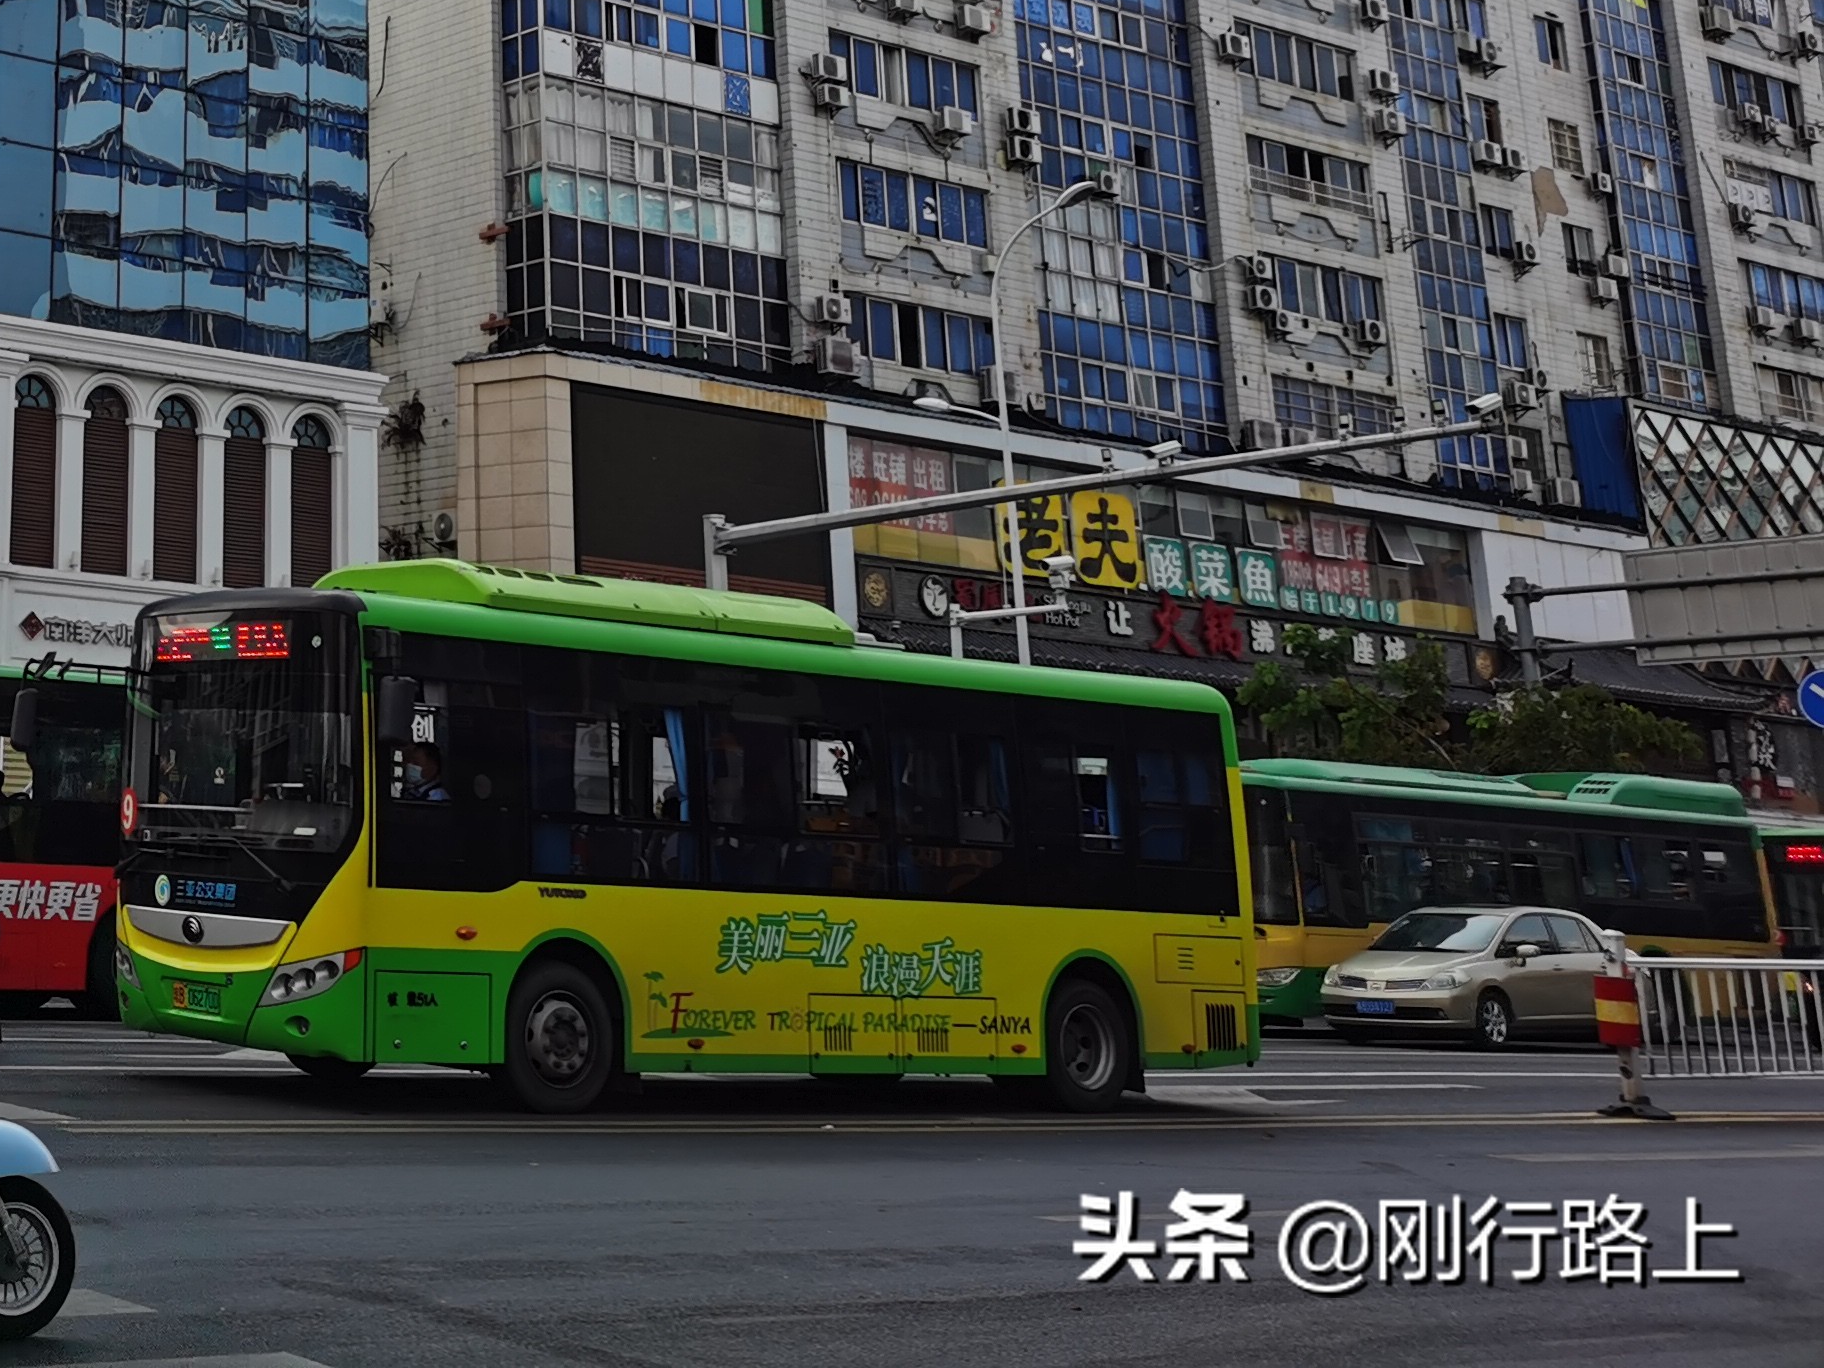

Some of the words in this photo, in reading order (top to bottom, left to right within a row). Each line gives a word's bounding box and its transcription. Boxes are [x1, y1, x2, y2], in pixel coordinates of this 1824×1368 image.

[1002, 495, 1138, 583] 老夫
[717, 910, 857, 973] 美丽三亚
[860, 937, 983, 998] 浪漫天涯
[767, 1010, 859, 1034] TROPICAL
